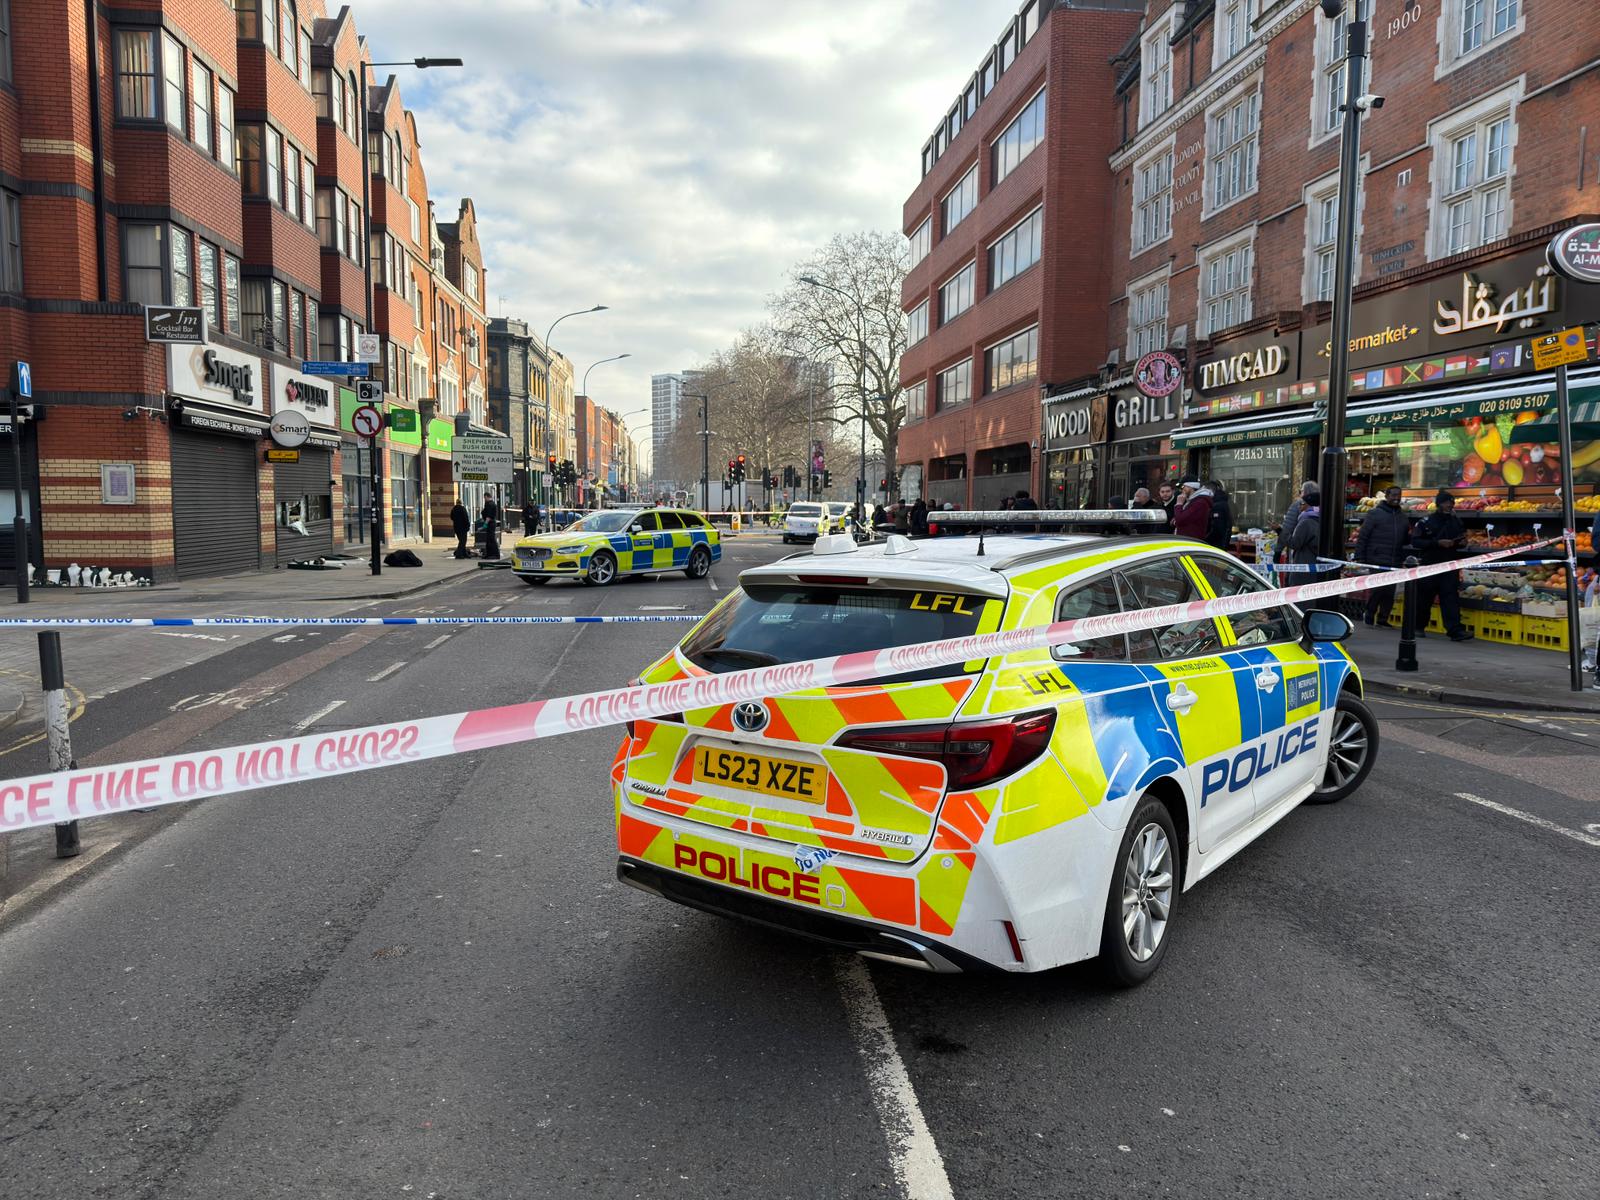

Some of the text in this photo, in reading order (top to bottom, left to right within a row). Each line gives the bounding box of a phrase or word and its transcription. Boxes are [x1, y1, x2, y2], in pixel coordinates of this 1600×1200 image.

[1387, 4, 1421, 40] 1900
[1176, 141, 1202, 166] LONDON
[1175, 164, 1200, 189] COUNTY
[155, 324, 194, 333] Cocktail Bar
[176, 310, 198, 325] fm
[166, 331, 199, 340] Restaurant
[203, 349, 254, 392] Smart
[1200, 345, 1282, 390] TIMGAD
[297, 381, 329, 407] SULTAN
[1479, 394, 1550, 413] 020 8109 5107
[1048, 406, 1091, 440] WOODY
[1115, 395, 1176, 428] GRILL
[191, 416, 209, 426] FOREIGN
[210, 419, 231, 431] EXCHANGE
[232, 423, 245, 433] MONEY
[244, 426, 262, 436] TRANSFER
[280, 424, 307, 433] Smart
[1247, 430, 1263, 440] FRUITS
[1268, 426, 1299, 437] VEGETABLES
[909, 593, 974, 616] LFL
[1018, 670, 1071, 695] LFL
[1301, 688, 1315, 700] POLICE
[703, 750, 815, 797] LS23 XZE
[1200, 716, 1319, 809] POLICE
[860, 829, 905, 845] HYBRID
[674, 843, 821, 905] POLICE
